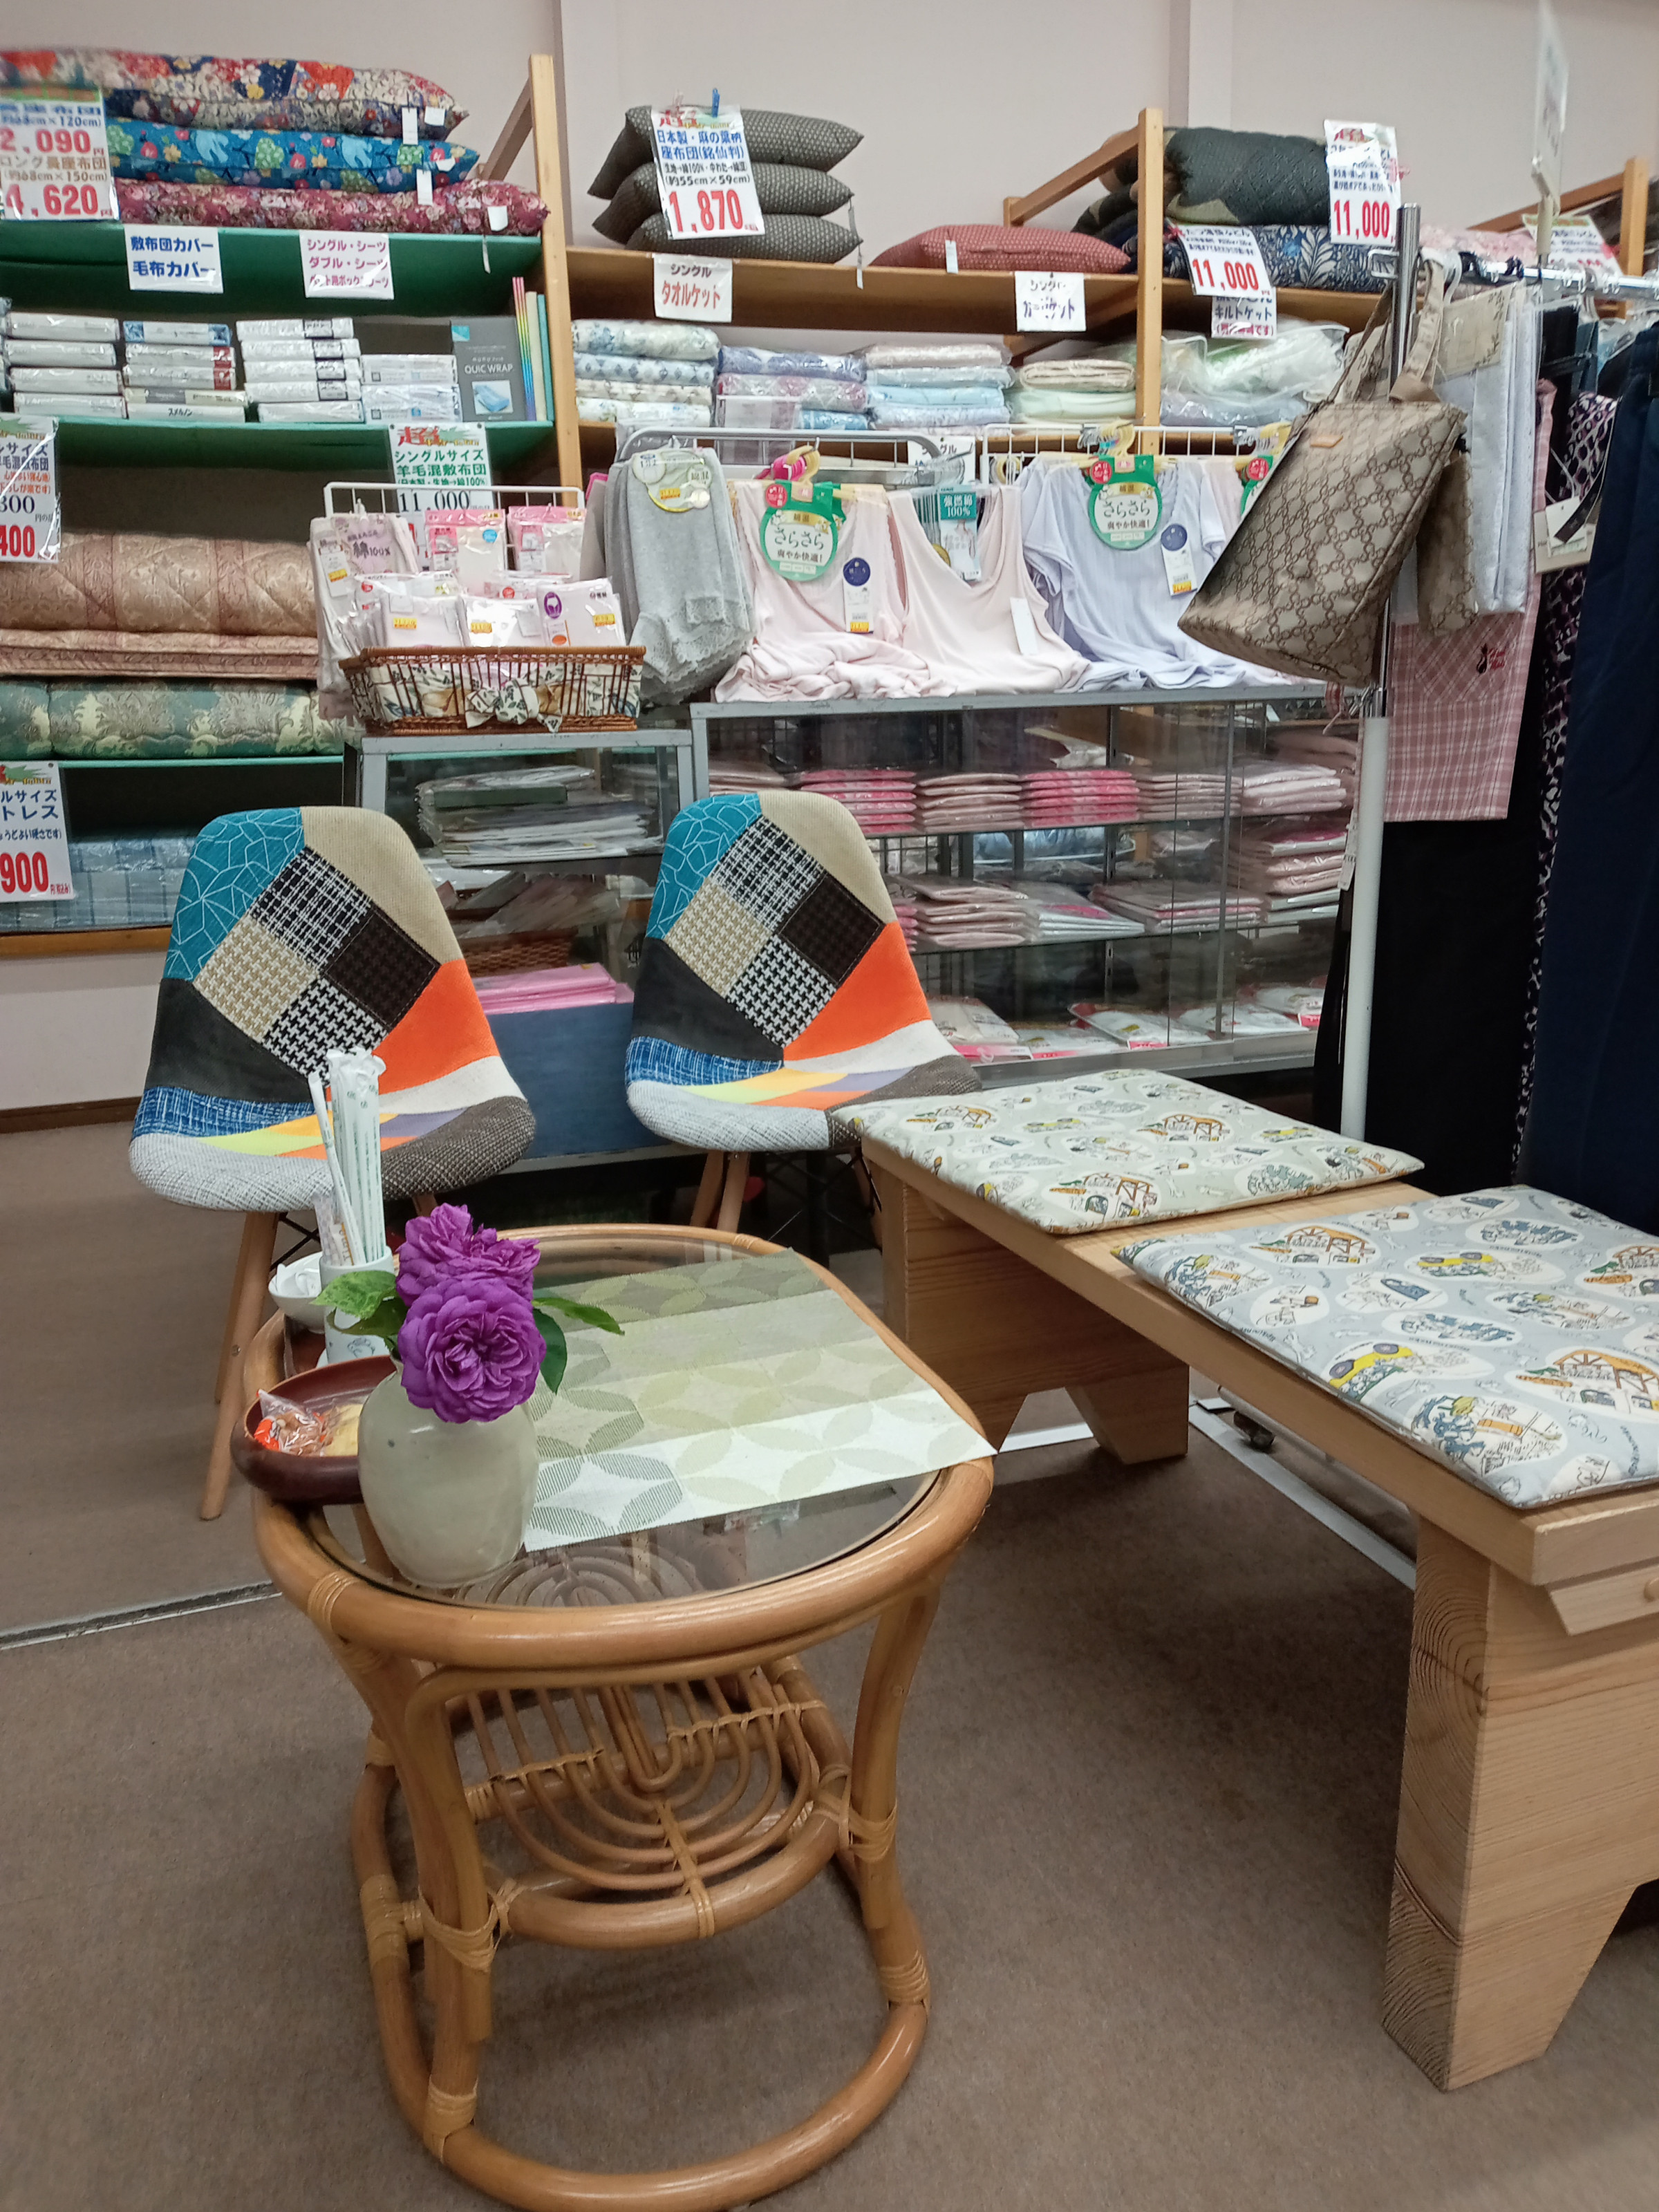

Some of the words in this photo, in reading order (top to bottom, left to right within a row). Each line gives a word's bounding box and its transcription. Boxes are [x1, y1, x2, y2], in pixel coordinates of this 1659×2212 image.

[6, 184, 98, 217] 4,620
[668, 189, 744, 233] 1,870
[1333, 200, 1390, 239] 11,000
[131, 236, 214, 252] 敷布団カバー
[308, 238, 386, 252] シングル・シーツ
[133, 260, 216, 278] 毛布カバー
[671, 263, 712, 278] シングル
[1192, 259, 1259, 291] 11,000
[662, 280, 721, 310] タオルケット
[465, 364, 486, 375] QUIC
[487, 363, 514, 373] WRAP
[395, 449, 484, 464] シングルサイズ
[397, 463, 487, 478] 羊毛混敷布団
[947, 506, 971, 518] 100%
[1103, 500, 1150, 518] さらさら
[774, 527, 824, 550] さらさら
[3, 805, 59, 821] トレス
[0, 851, 49, 894] 900
